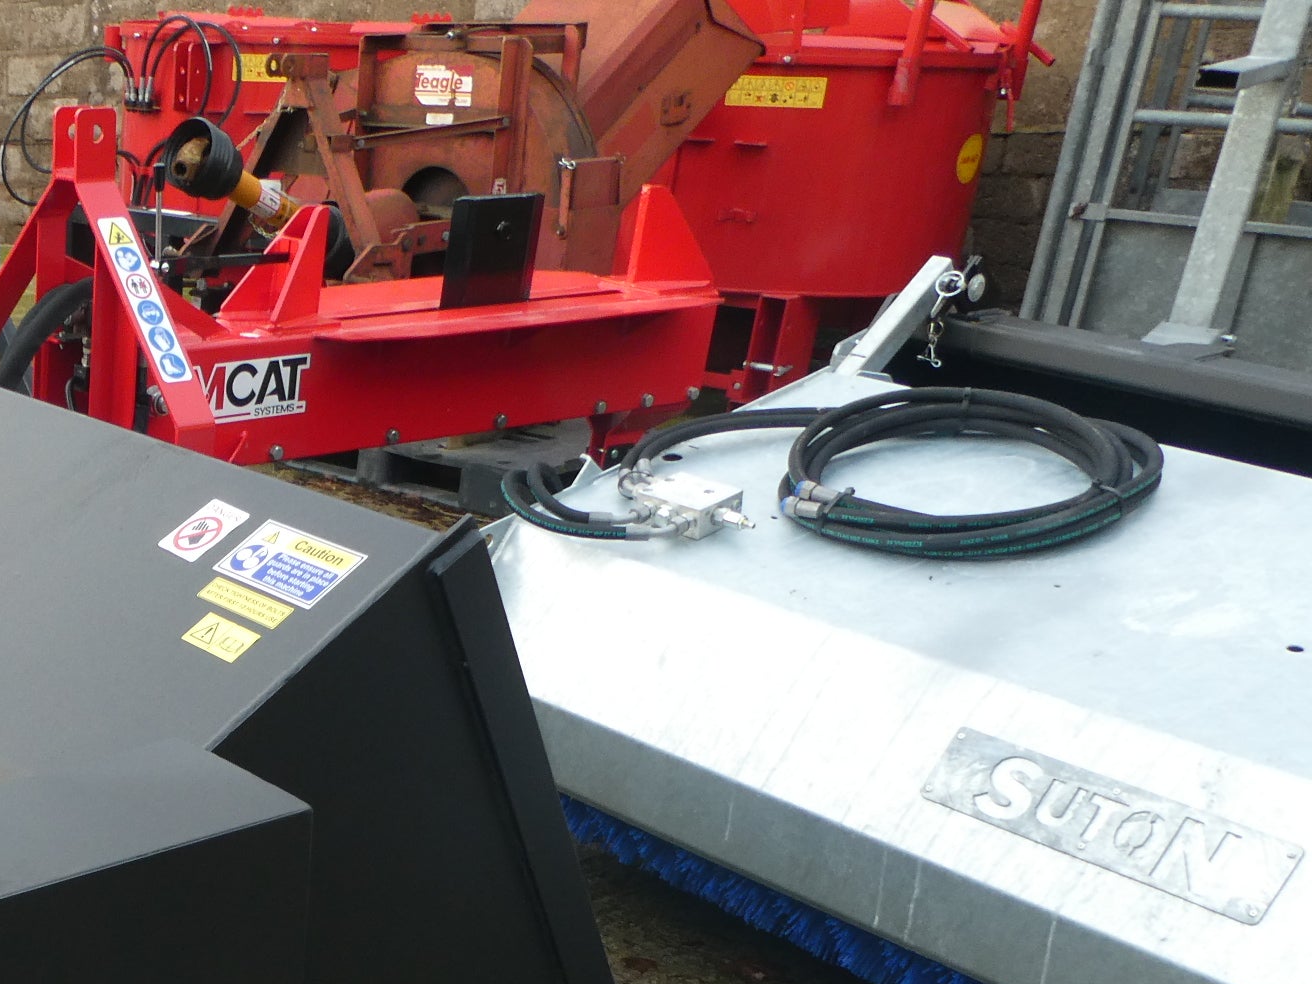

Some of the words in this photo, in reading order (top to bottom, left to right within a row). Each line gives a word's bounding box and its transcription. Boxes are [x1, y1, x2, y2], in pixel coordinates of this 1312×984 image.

[415, 71, 463, 93] Teagle
[253, 403, 295, 417] SYSTEMS
[294, 540, 344, 566] Caution
[266, 567, 289, 581] before
[287, 577, 315, 593] starting
[275, 581, 305, 598] machine
[972, 755, 1244, 898] SUTON
